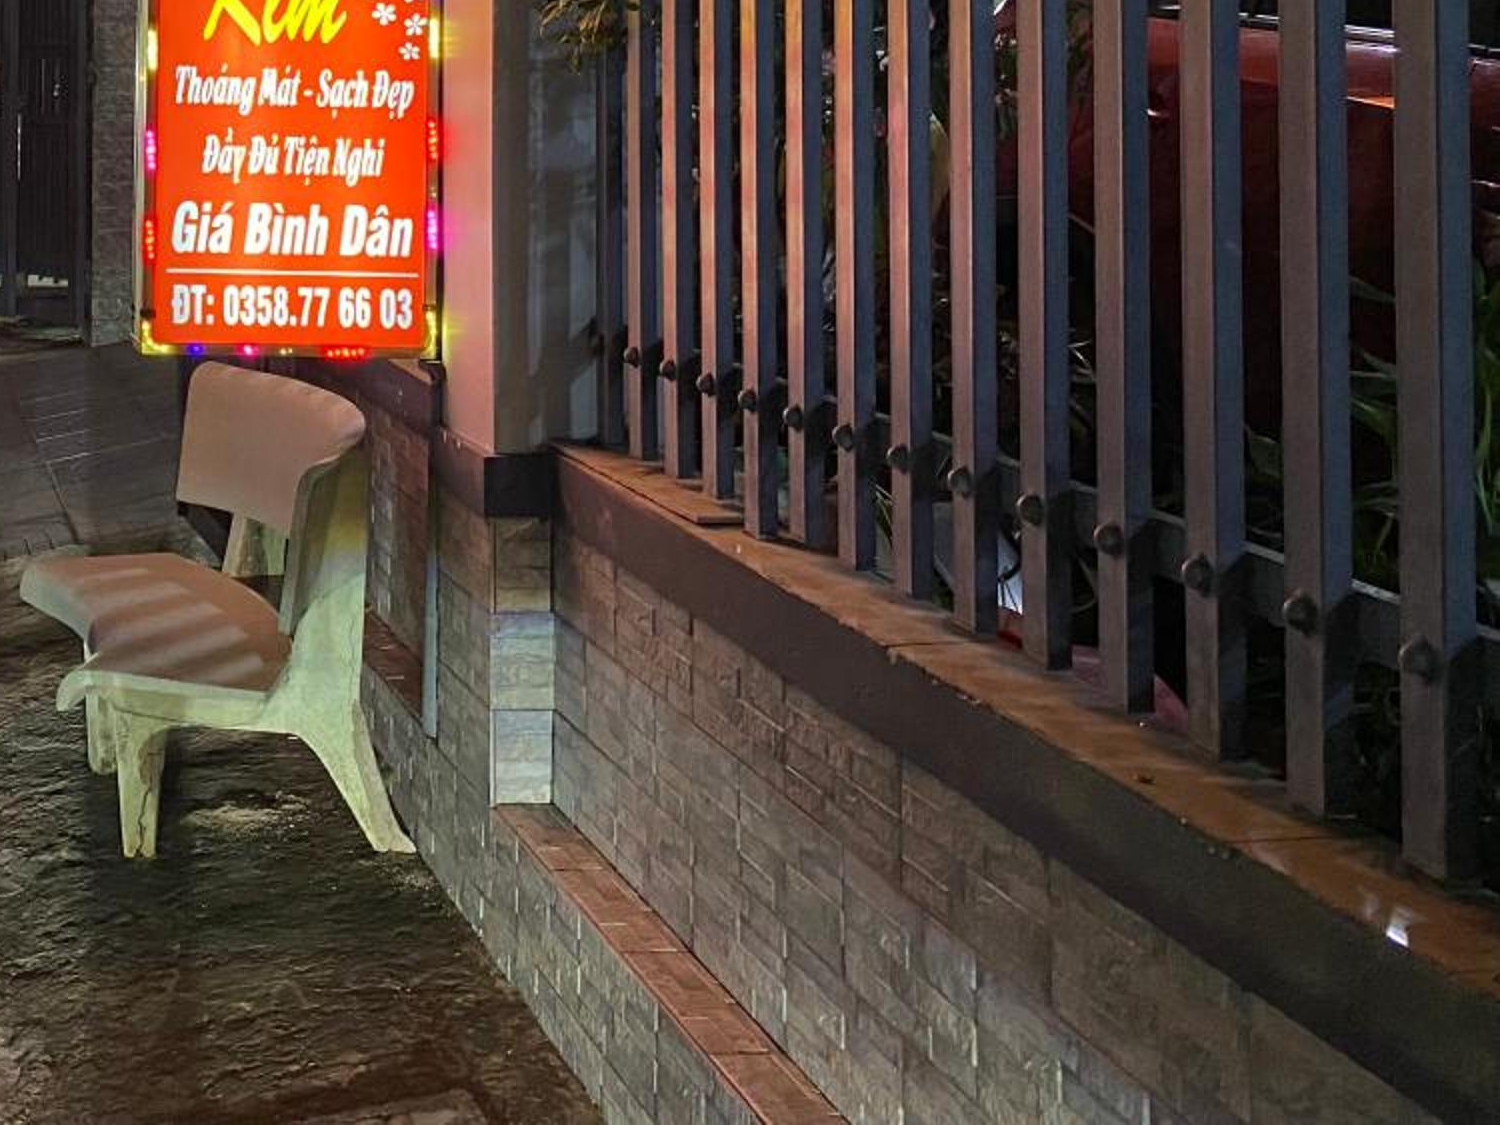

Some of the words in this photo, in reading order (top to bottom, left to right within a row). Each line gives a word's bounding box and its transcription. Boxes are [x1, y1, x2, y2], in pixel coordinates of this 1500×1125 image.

[175, 63, 255, 117] Thoáng
[257, 65, 301, 106] Mát
[316, 68, 369, 120] Sạch
[371, 70, 415, 120] Đẹp
[248, 133, 280, 175] Đủ
[283, 135, 330, 187] Tiện
[171, 200, 235, 254] Giá
[243, 202, 329, 256] Bình
[339, 204, 414, 258] Dân
[172, 283, 215, 325] ĐT:
[223, 285, 330, 328] 0358.77
[339, 287, 372, 330] 66
[380, 288, 413, 330] 03
